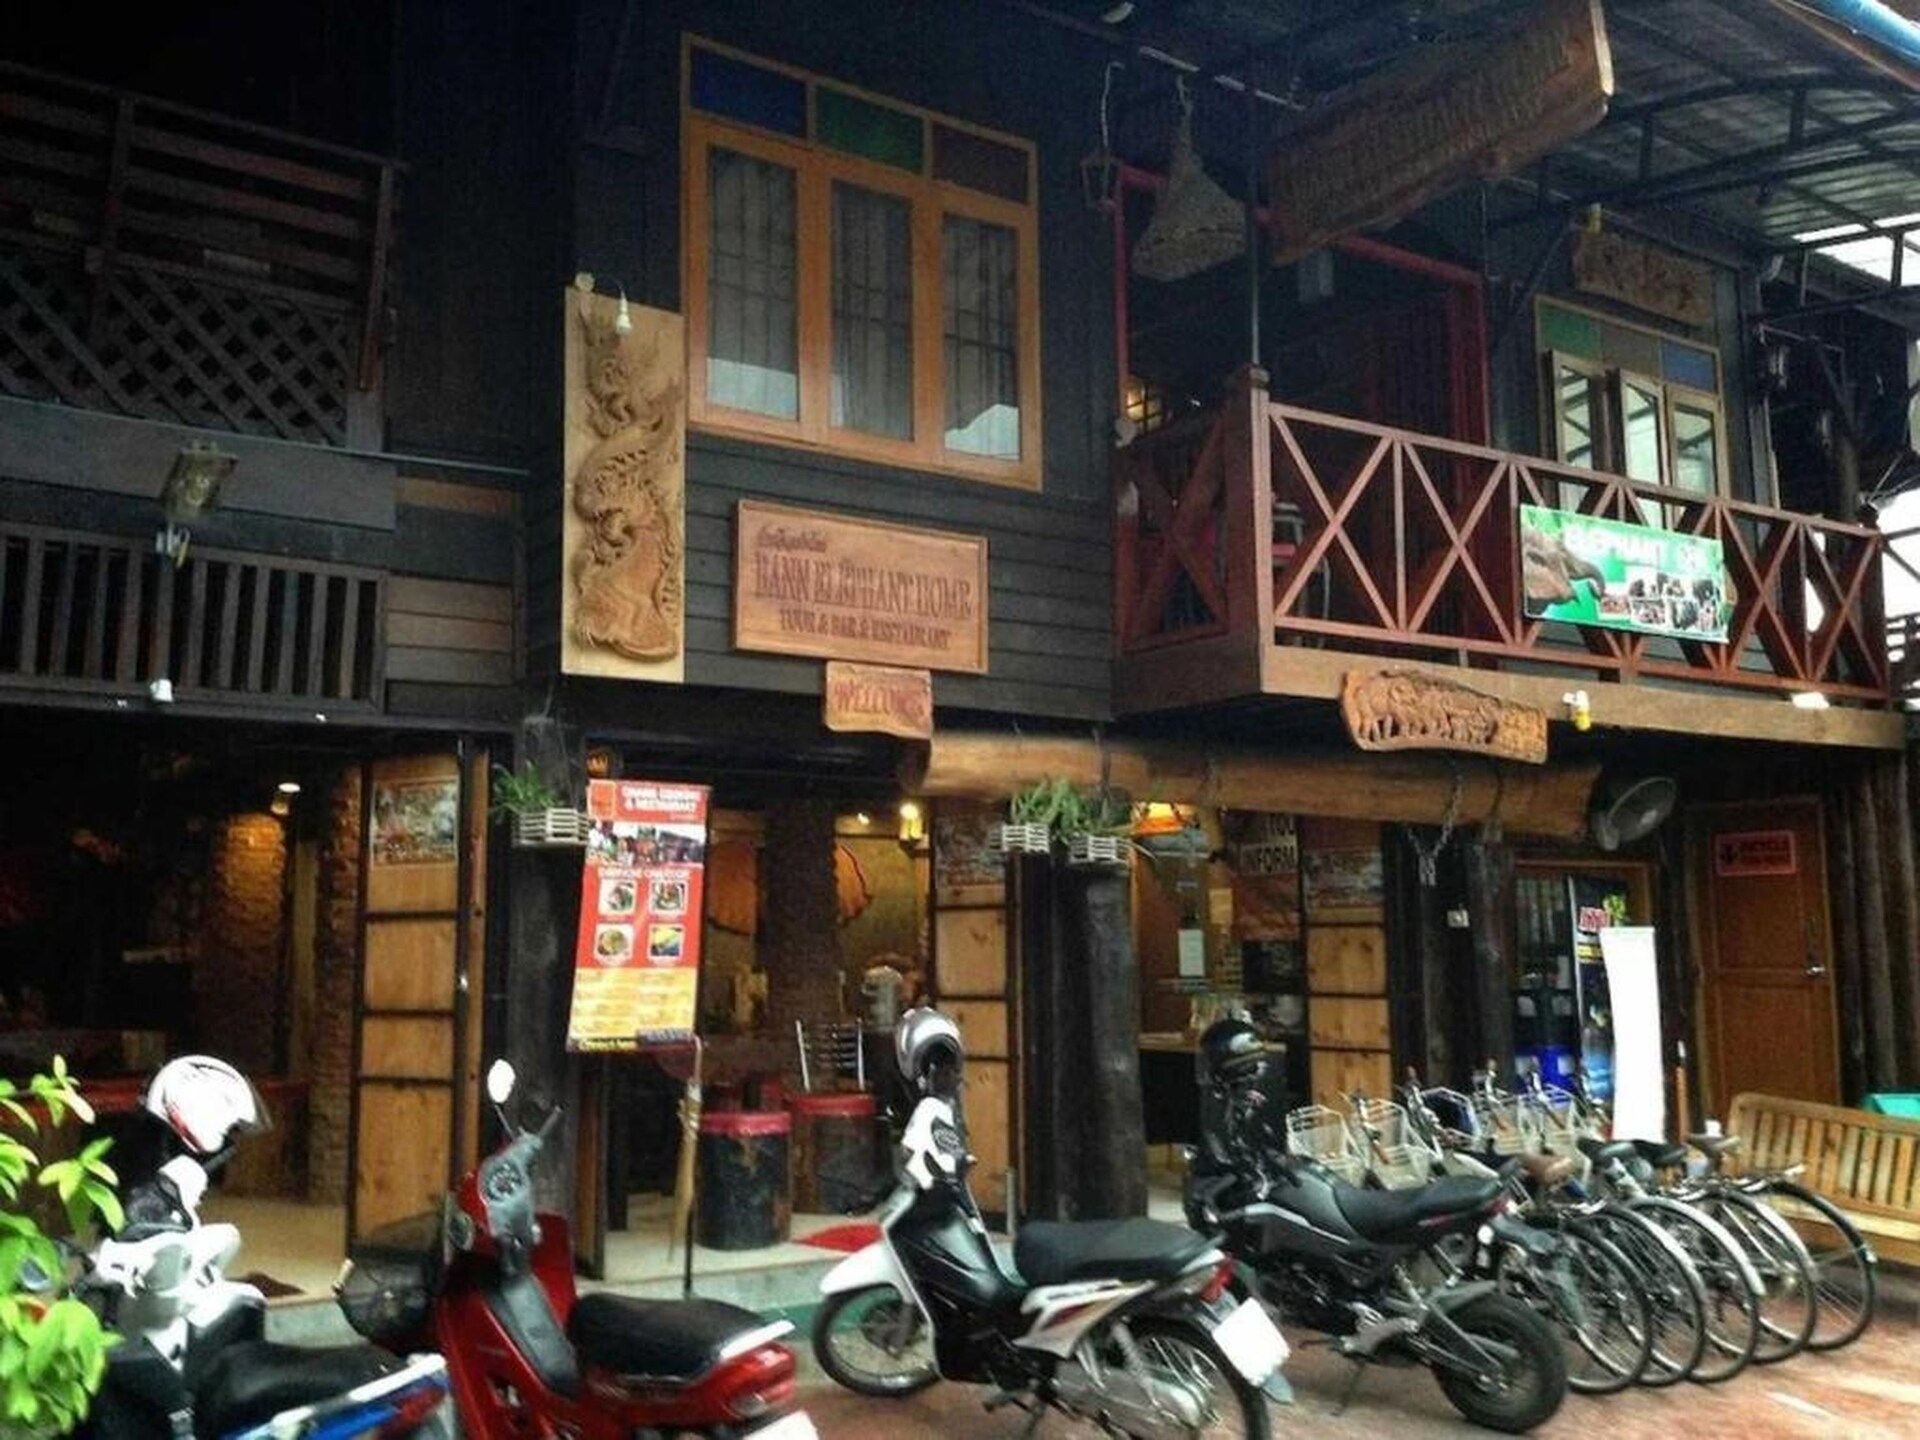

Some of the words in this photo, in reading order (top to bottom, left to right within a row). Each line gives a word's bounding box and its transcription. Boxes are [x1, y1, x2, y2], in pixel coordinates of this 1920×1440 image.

[813, 558, 915, 615] ELEPHANT
[917, 575, 971, 619] HOME
[780, 608, 816, 633] TOUR
[818, 612, 829, 634] &
[831, 615, 858, 639] BAR
[870, 621, 950, 650] RESTAURANT
[834, 678, 924, 717] WELCOME
